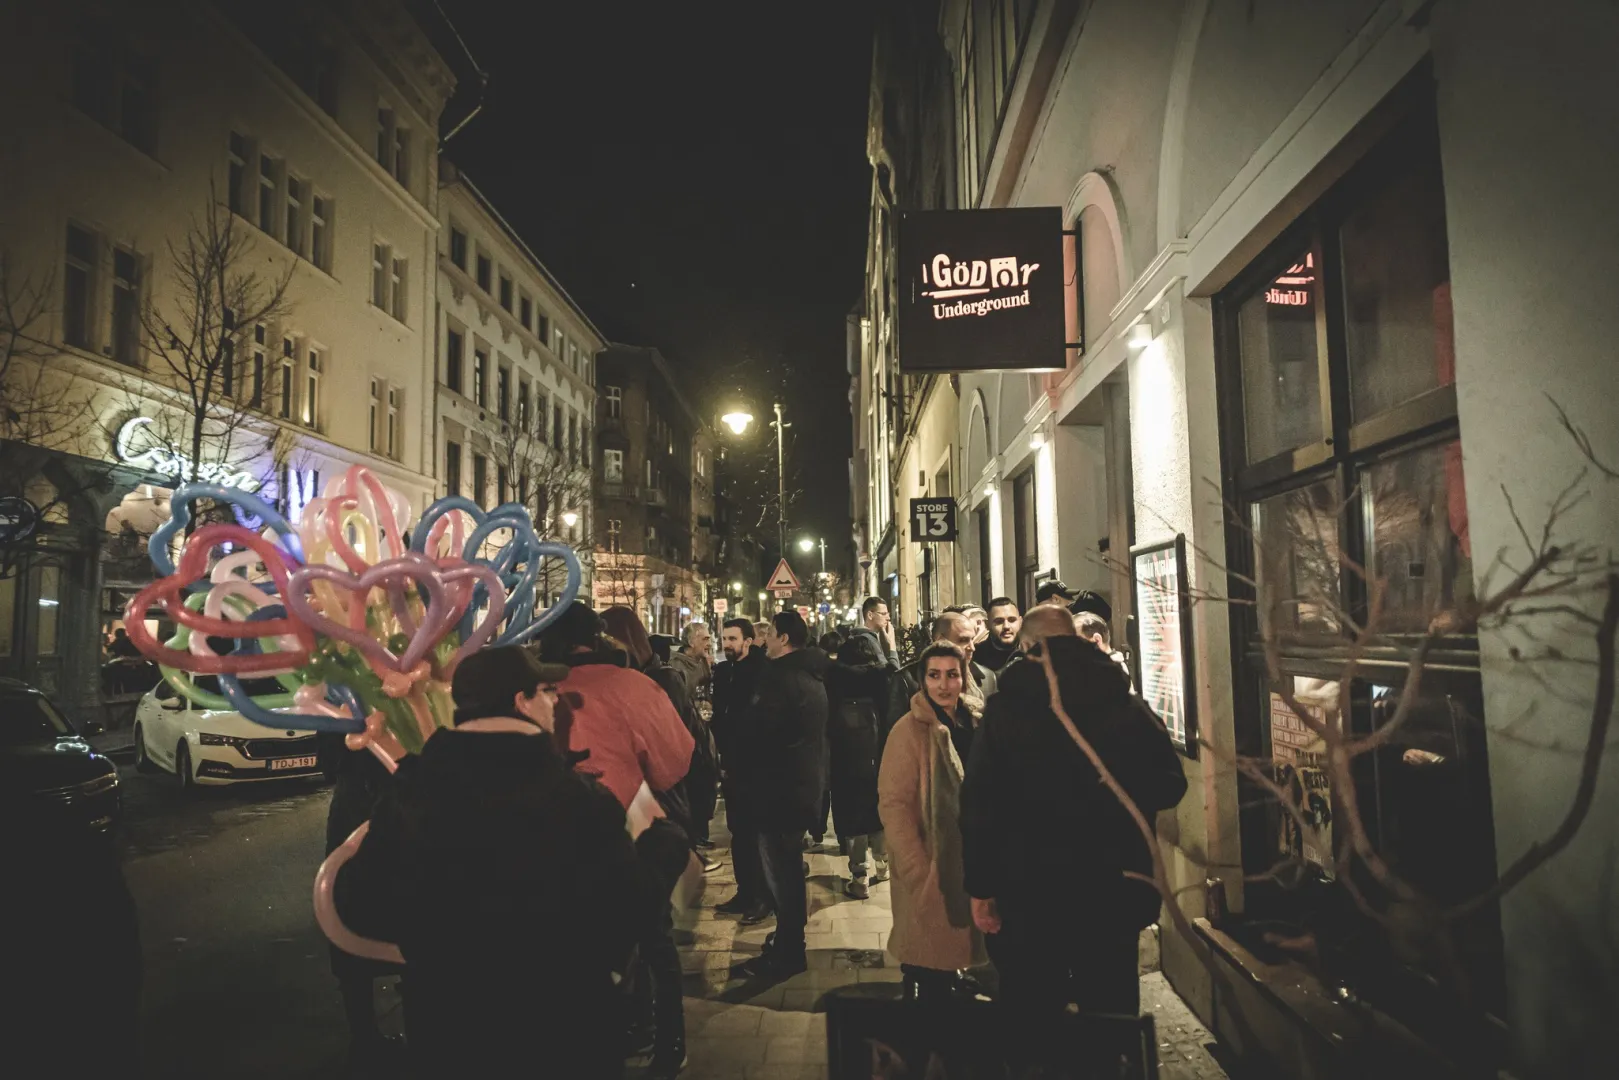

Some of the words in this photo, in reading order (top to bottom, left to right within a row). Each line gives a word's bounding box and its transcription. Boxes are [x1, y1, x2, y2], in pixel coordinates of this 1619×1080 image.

[932, 289, 1031, 320] Underground
[916, 503, 949, 513] STORE
[916, 512, 949, 537] 13
[274, 757, 315, 769] TDJ-191
